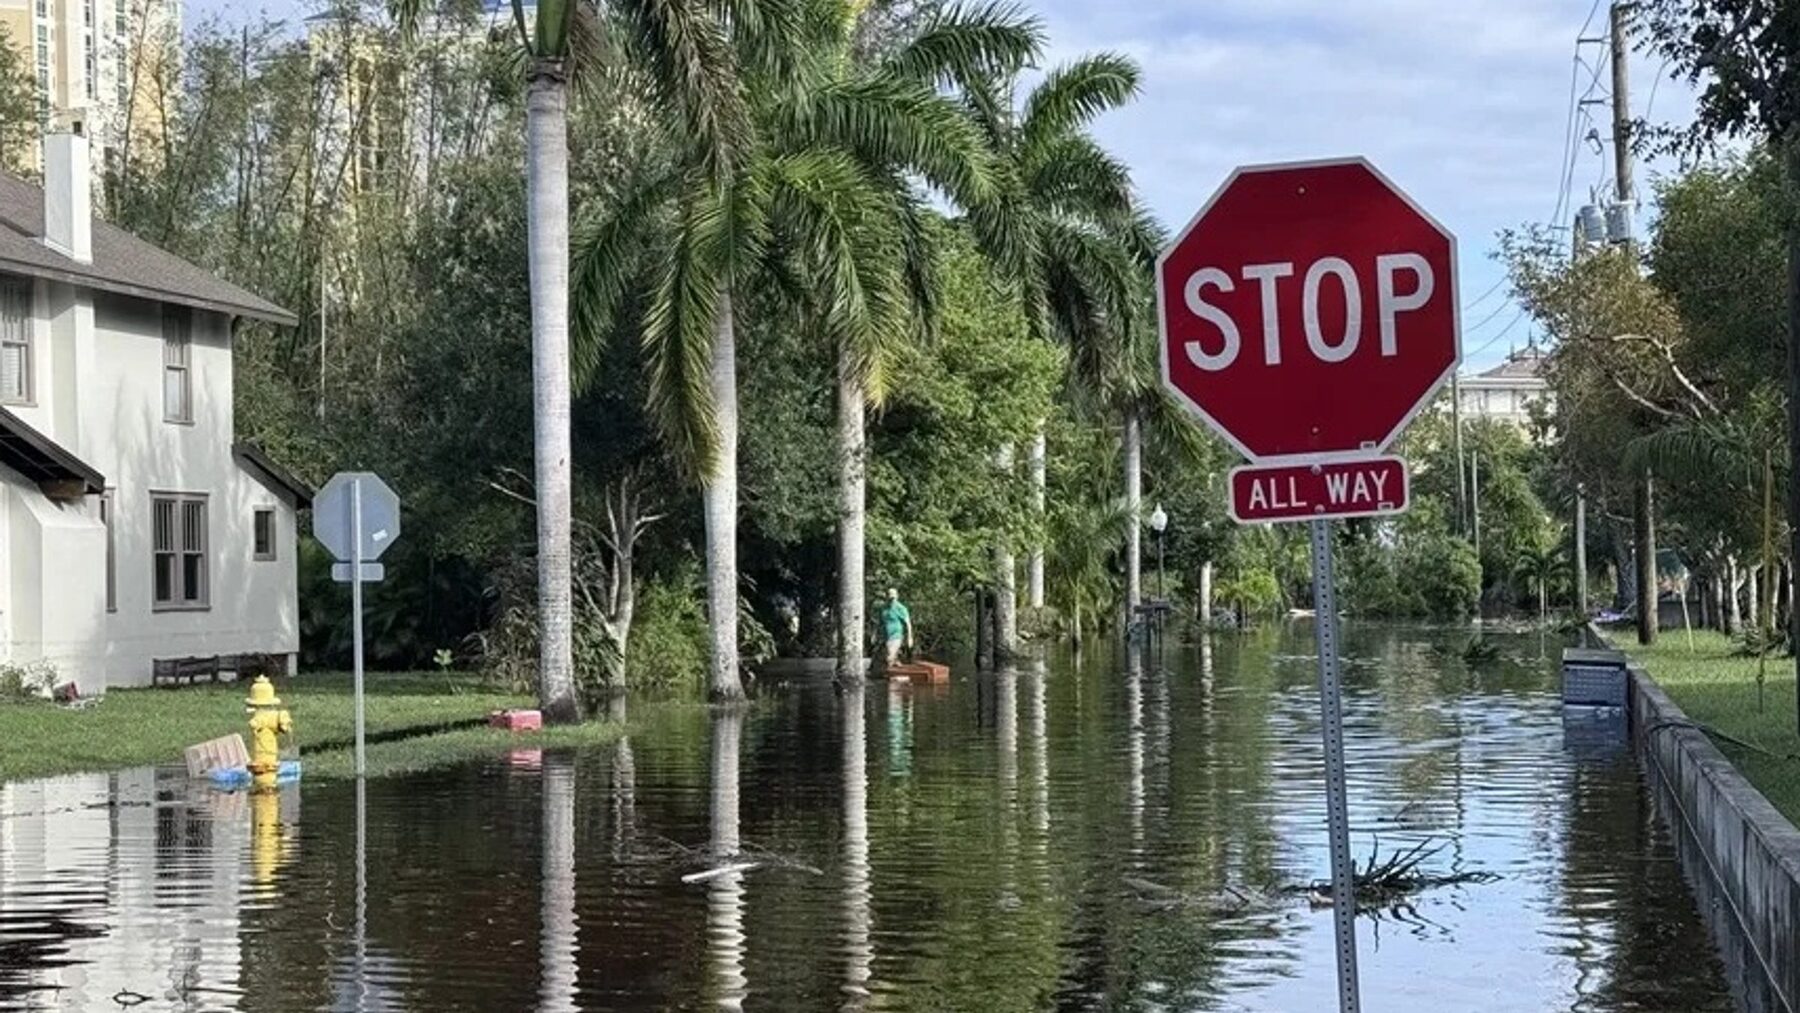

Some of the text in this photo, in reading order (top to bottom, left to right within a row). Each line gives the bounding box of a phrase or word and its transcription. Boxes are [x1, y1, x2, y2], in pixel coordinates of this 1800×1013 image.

[1184, 252, 1434, 371] STOP
[1248, 470, 1389, 510] ALL WAY
